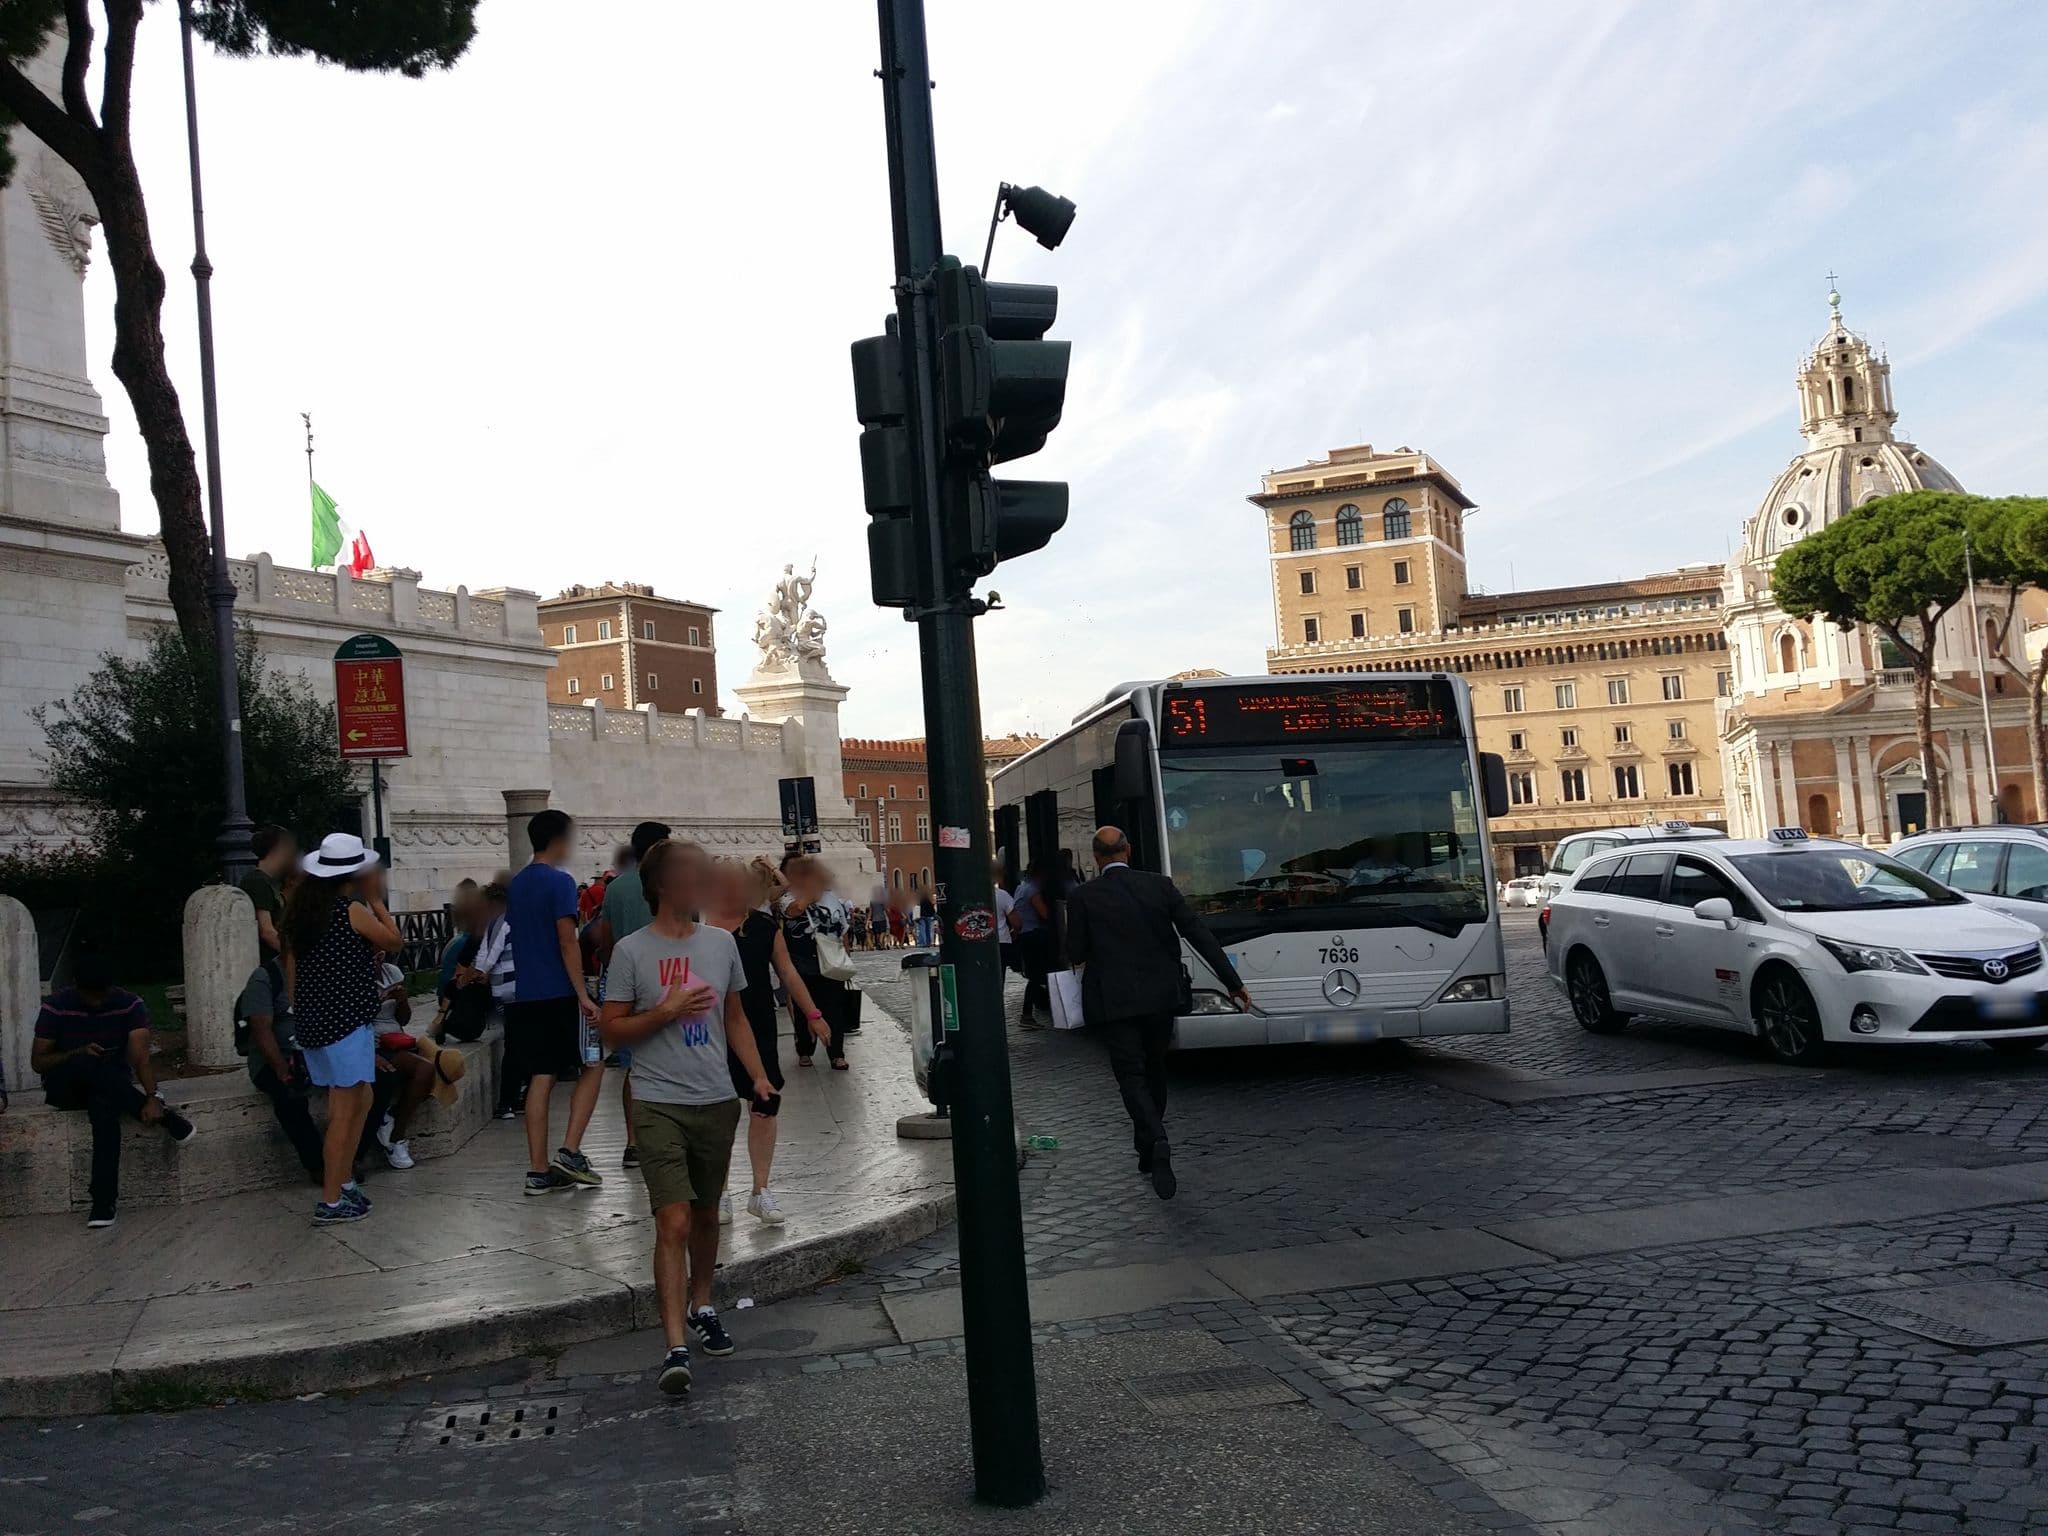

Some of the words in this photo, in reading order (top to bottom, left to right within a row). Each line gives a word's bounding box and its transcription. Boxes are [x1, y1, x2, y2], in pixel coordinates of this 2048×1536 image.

[1170, 698, 1207, 735] 51
[1666, 821, 1688, 829] TAXI
[1774, 828, 1807, 840] TAXI
[1318, 947, 1360, 964] 7636
[658, 957, 690, 987] VAI
